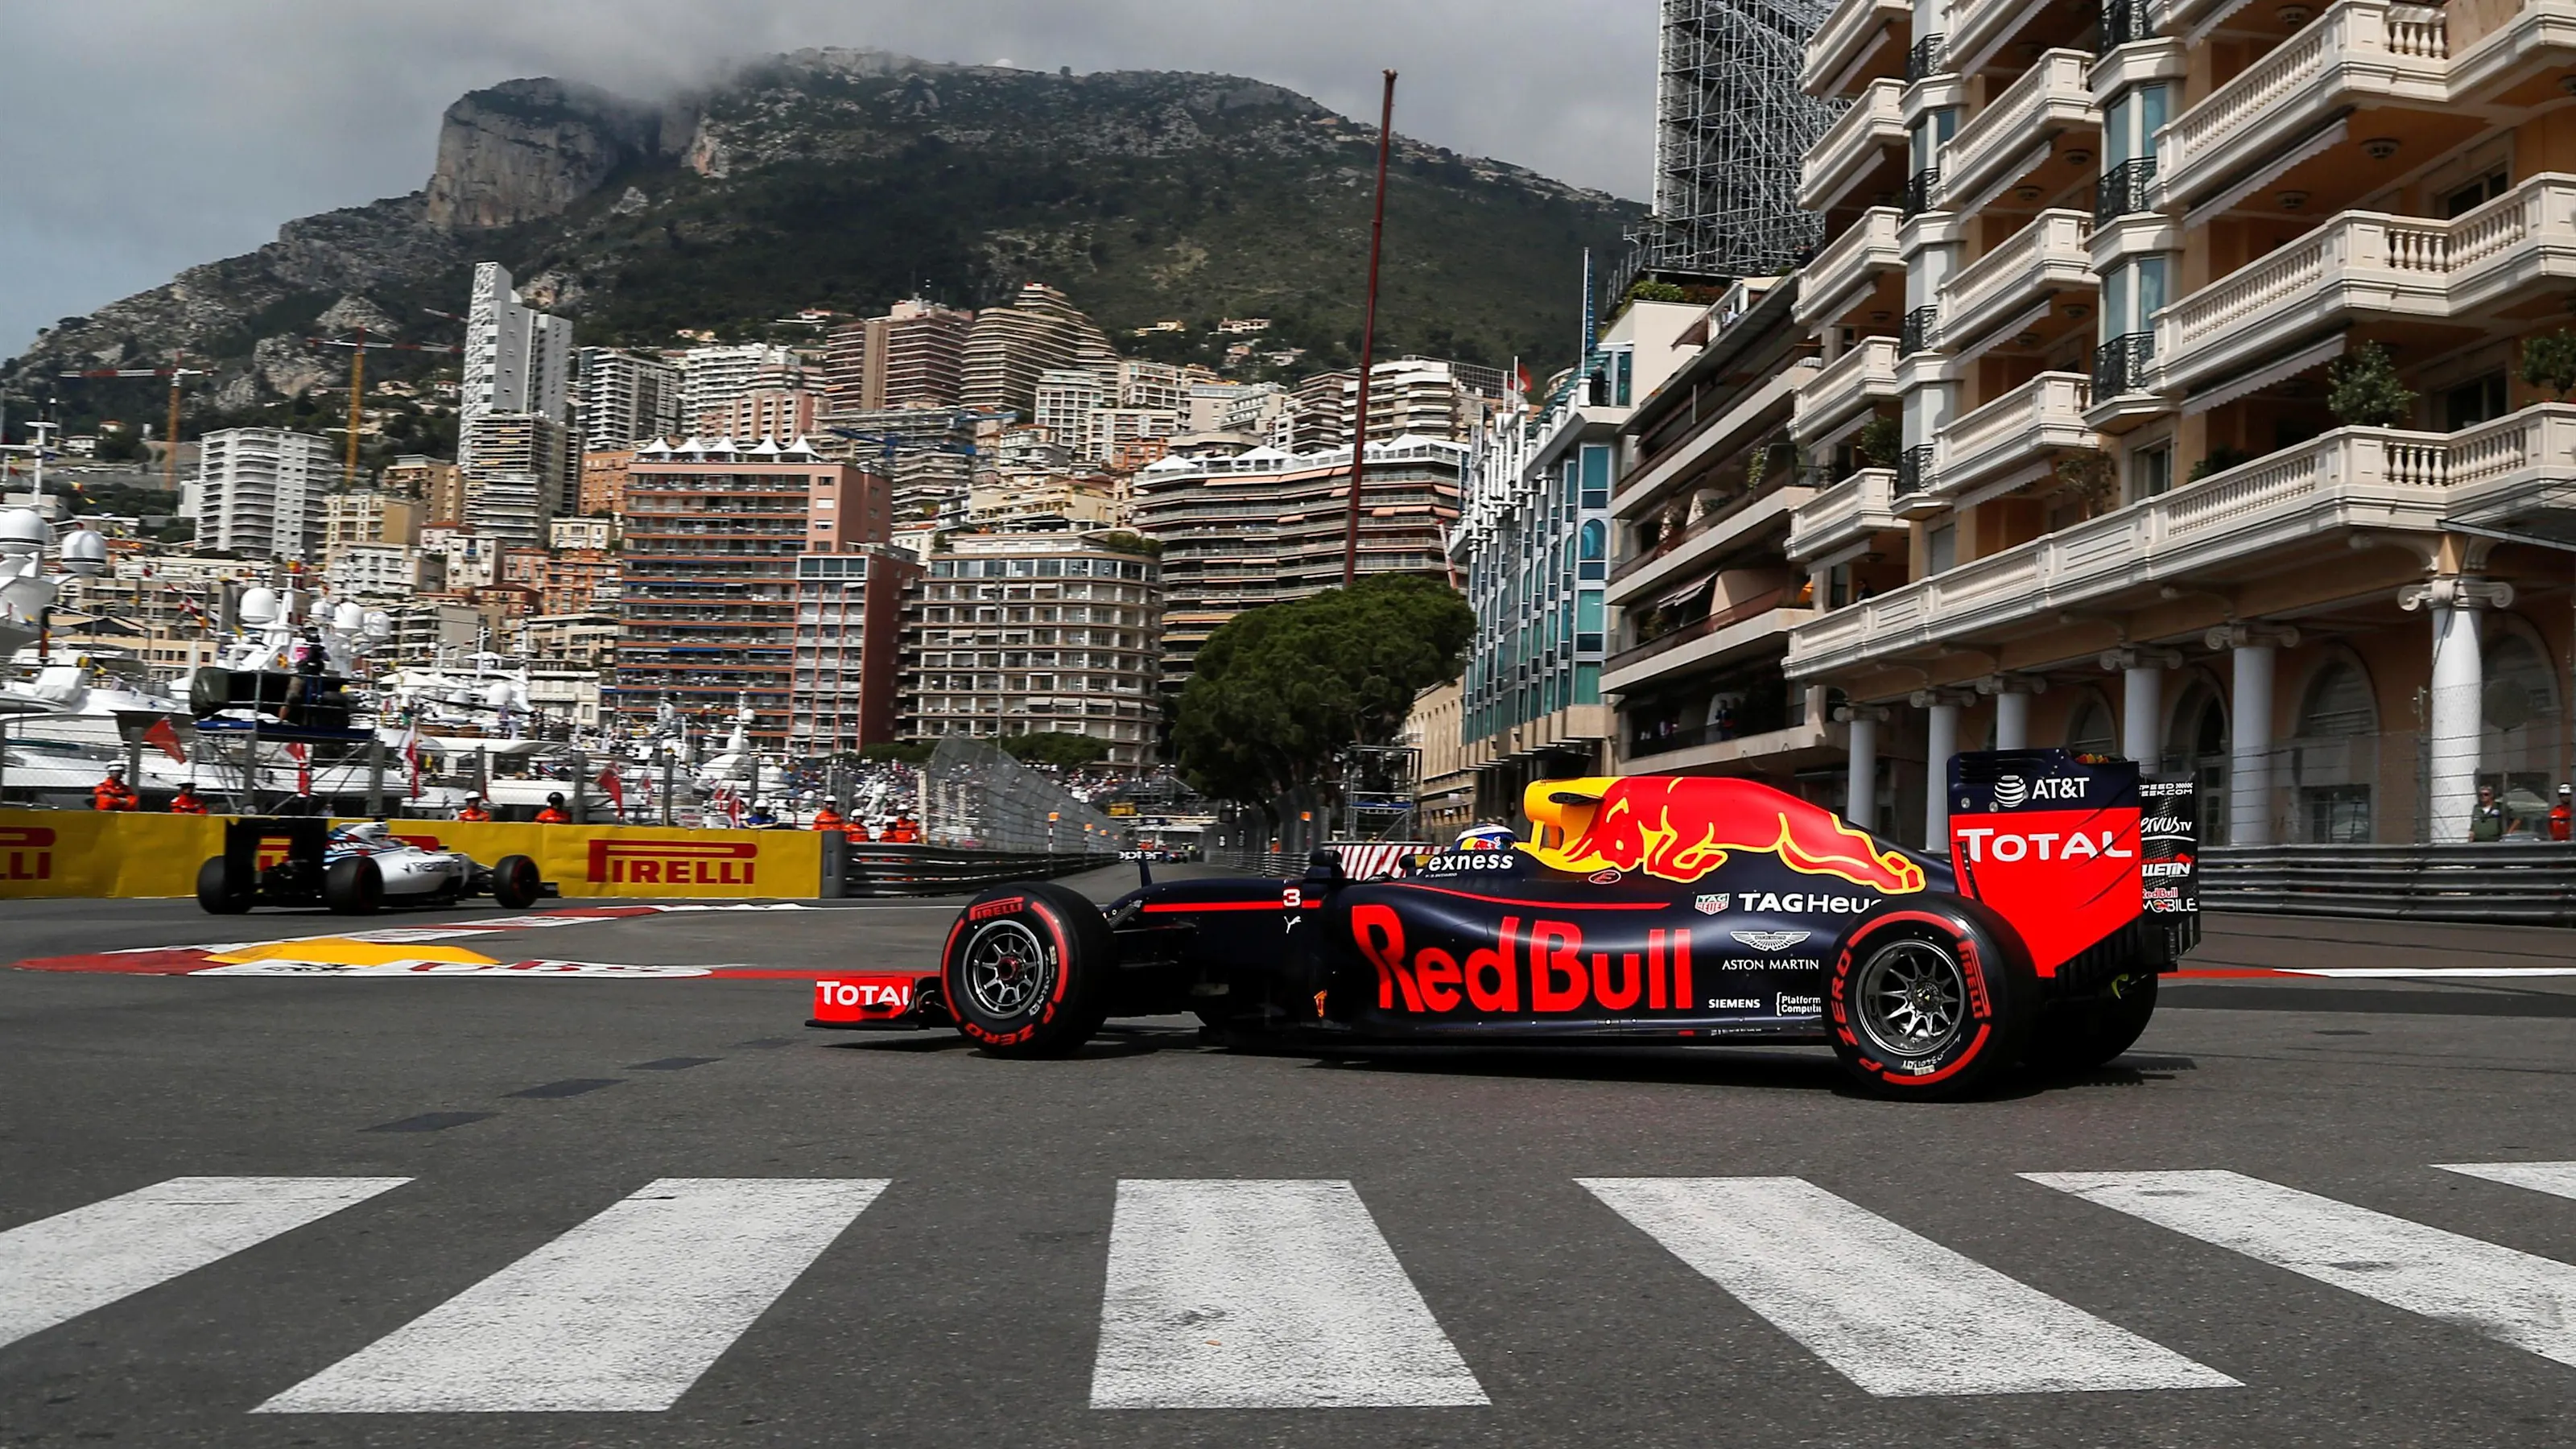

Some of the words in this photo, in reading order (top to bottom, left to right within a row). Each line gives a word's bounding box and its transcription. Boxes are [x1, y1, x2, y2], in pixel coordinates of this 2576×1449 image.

[2031, 777, 2091, 800] AT&T
[2139, 789, 2193, 797] EEK.COM
[1957, 828, 2133, 863] TOTAL
[587, 839, 758, 885] PIRELLI
[1428, 853, 1514, 872] exness
[2141, 863, 2191, 877] LLETIN
[1282, 888, 1301, 906] 3
[1698, 894, 1728, 902] TAG
[968, 896, 1025, 922] PIRELLI
[1351, 904, 1521, 1013] Red
[1529, 919, 1693, 1013] Bull
[1722, 959, 1764, 971] ASTON
[1769, 959, 1819, 971] MARTIN
[1956, 938, 1992, 1020] PIRELLI
[1708, 998, 1761, 1009] SIEMENS
[1781, 995, 1822, 1005] Platform
[1831, 948, 1859, 1046] ZERO
[964, 1023, 1035, 1046] ZERO
